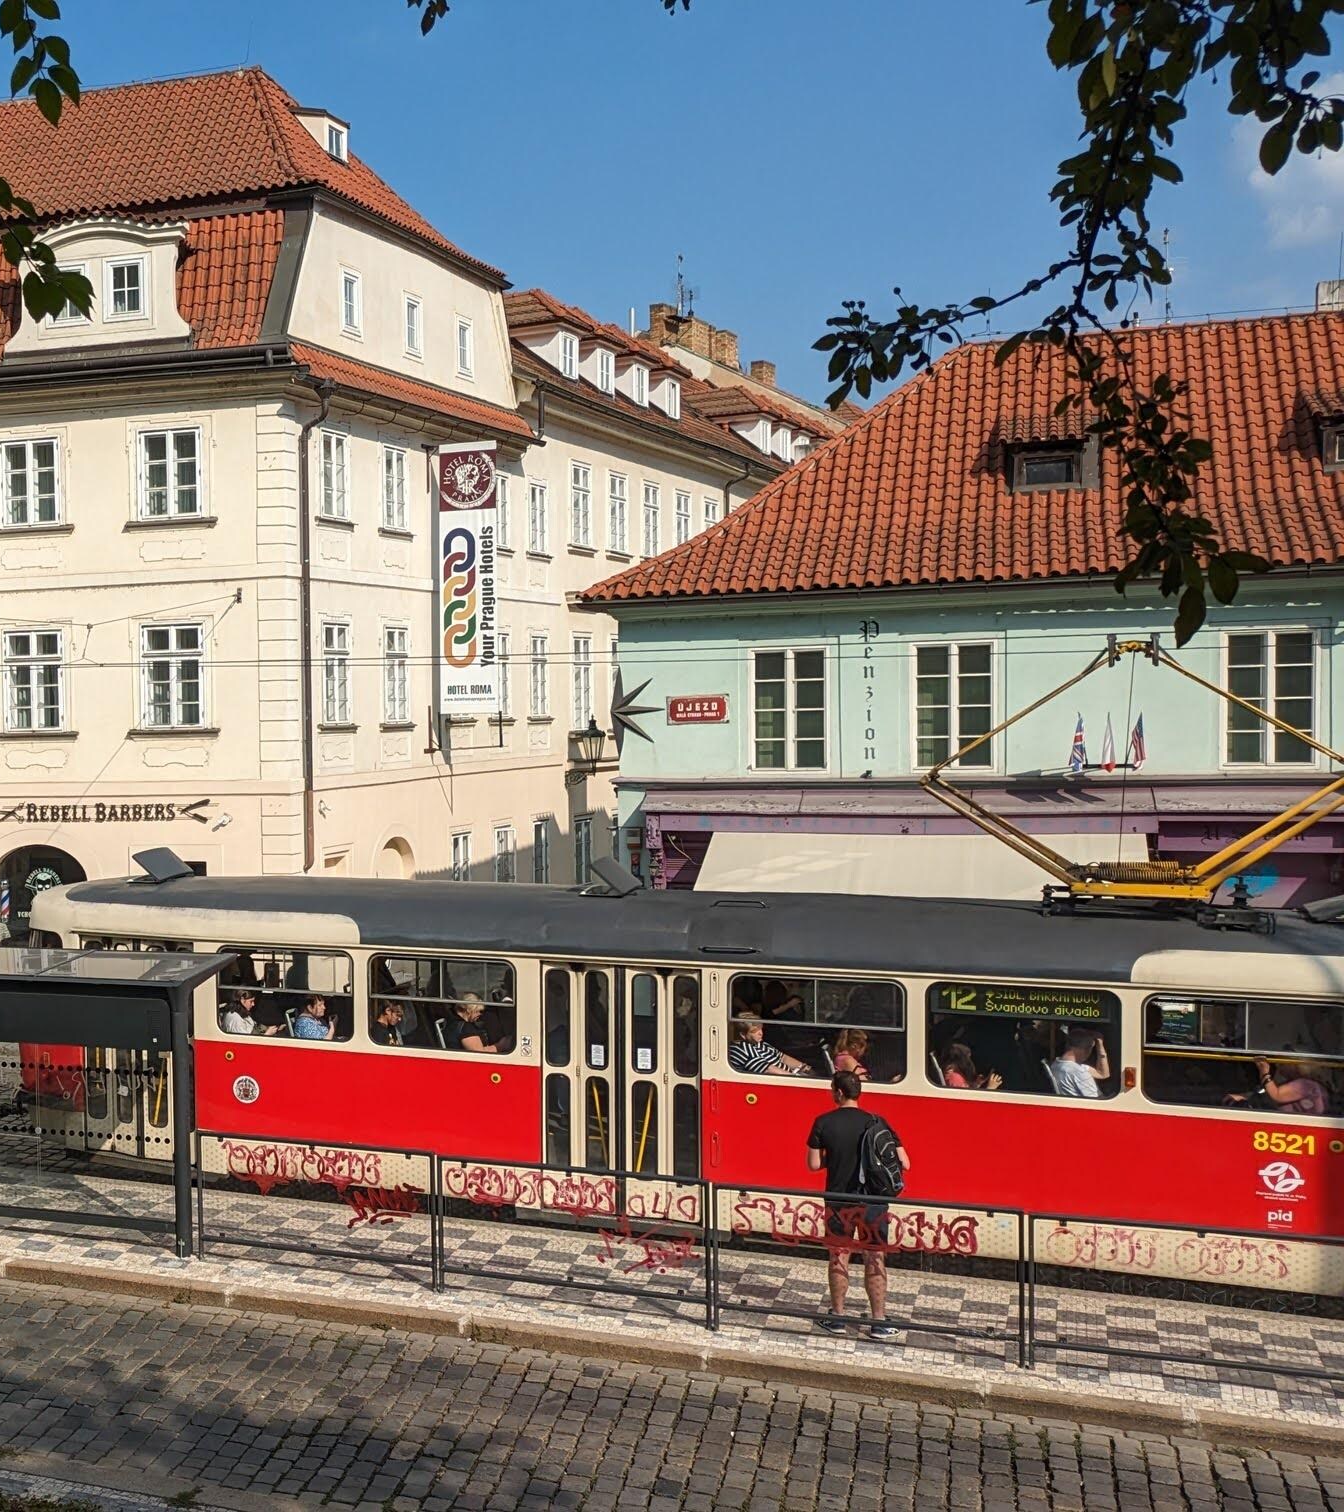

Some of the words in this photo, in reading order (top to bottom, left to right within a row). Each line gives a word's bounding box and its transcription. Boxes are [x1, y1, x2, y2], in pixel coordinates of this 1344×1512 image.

[479, 525, 494, 575] Hotels
[480, 577, 496, 631] Prague
[480, 633, 494, 667] Your
[447, 685, 468, 695] HOTEL
[470, 684, 492, 694] ROMA
[858, 620, 880, 760] Penzion
[677, 702, 718, 712] ÚJEZD
[25, 803, 91, 823] REBELL
[94, 802, 176, 823] BARBERS
[942, 985, 977, 1011] 12
[1253, 1131, 1315, 1155] 8521
[1267, 1209, 1293, 1222] pid
